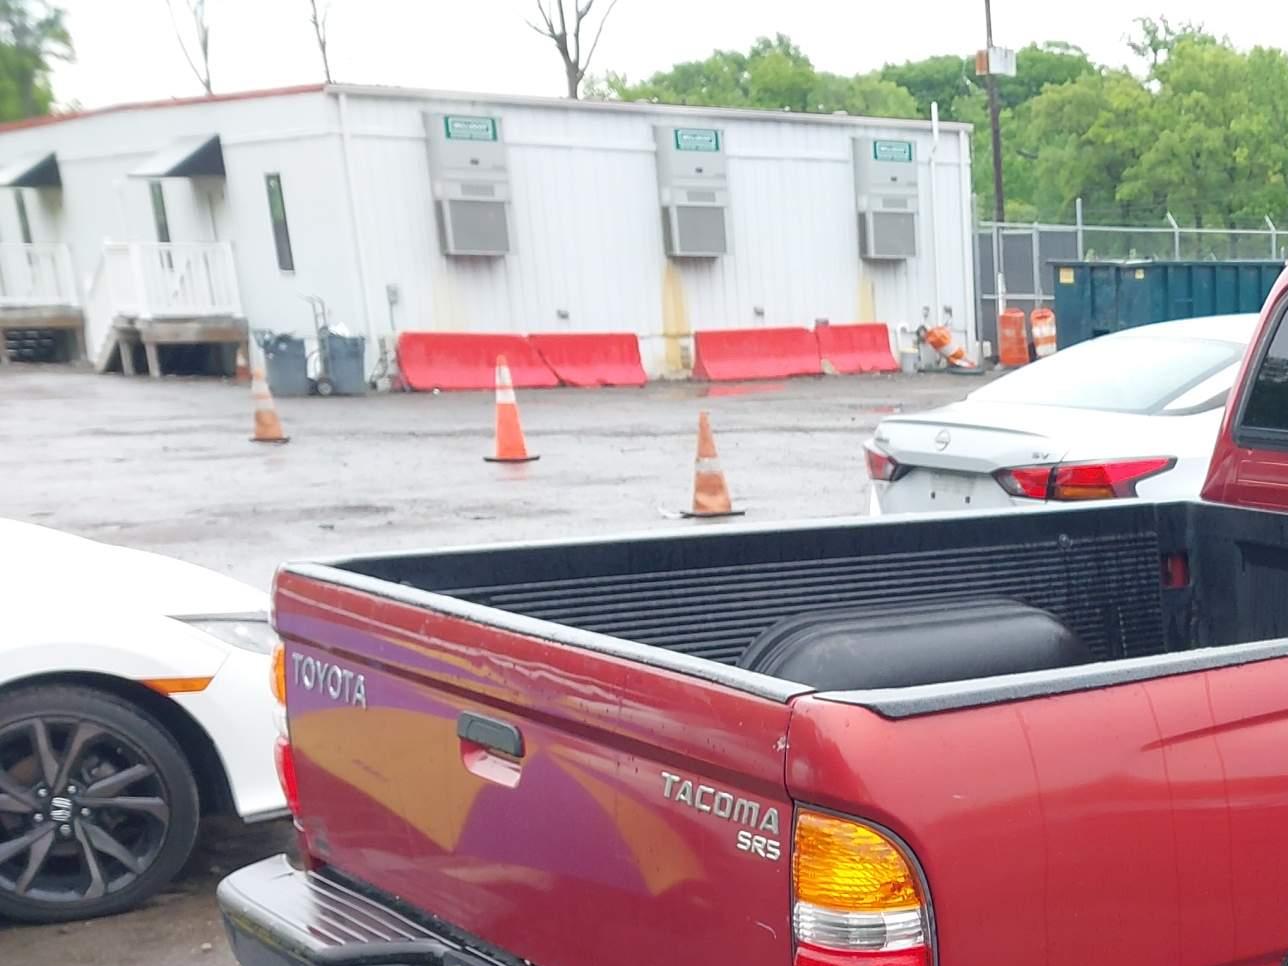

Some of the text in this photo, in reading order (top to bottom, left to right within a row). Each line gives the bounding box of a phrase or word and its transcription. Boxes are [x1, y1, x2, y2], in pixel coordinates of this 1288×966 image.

[292, 651, 367, 710] TOYOTA
[661, 771, 780, 835] TACOMA
[736, 829, 781, 861] SR5
